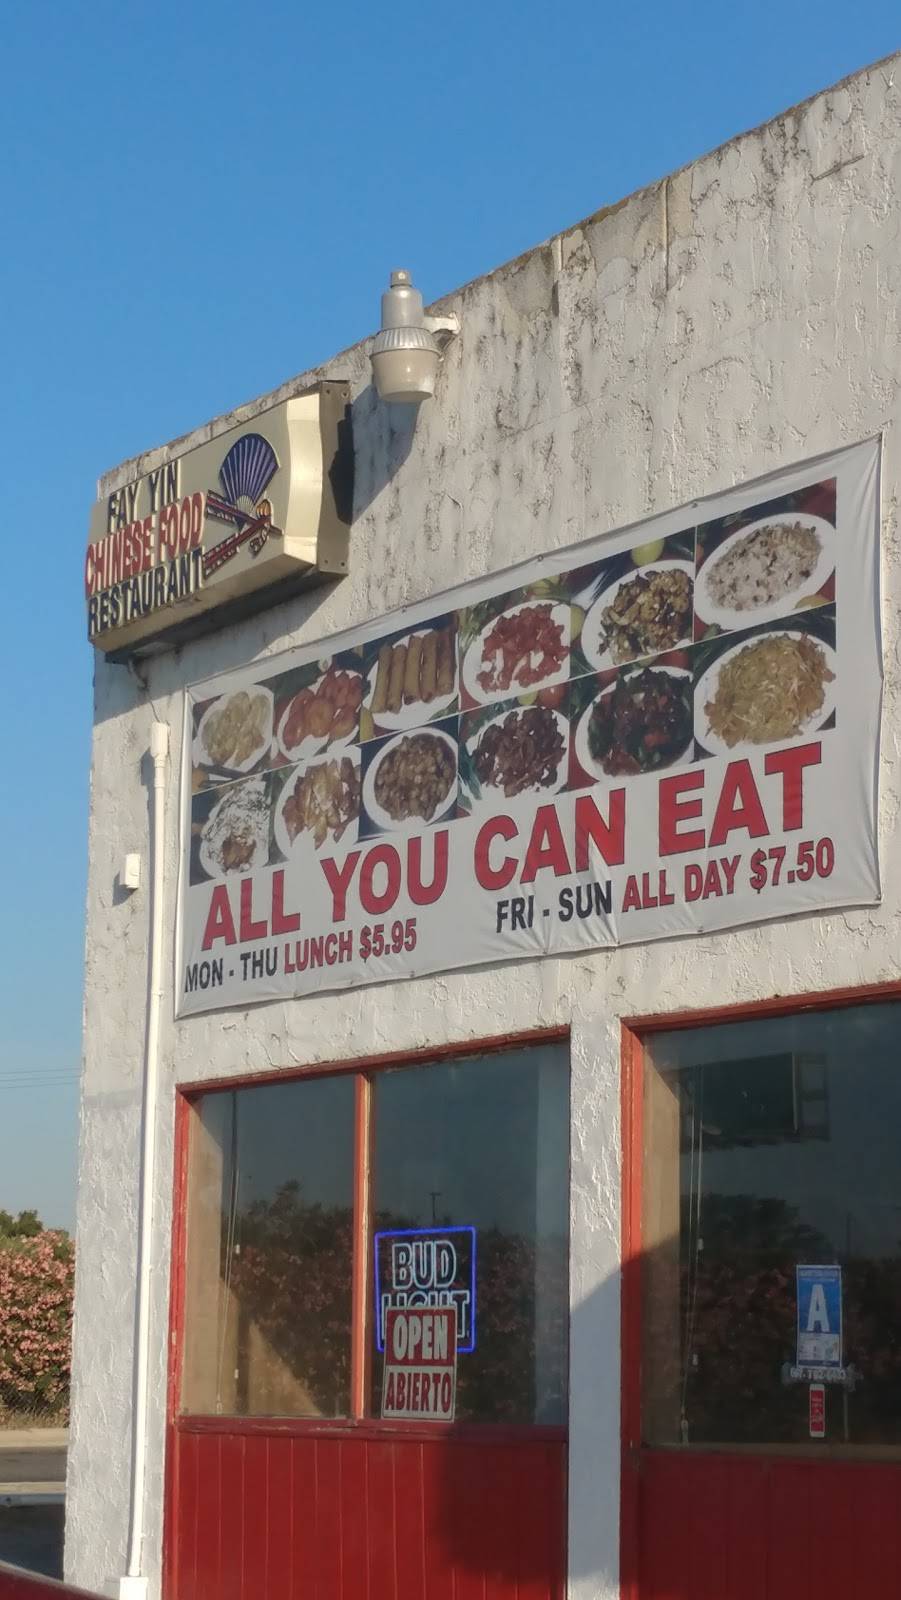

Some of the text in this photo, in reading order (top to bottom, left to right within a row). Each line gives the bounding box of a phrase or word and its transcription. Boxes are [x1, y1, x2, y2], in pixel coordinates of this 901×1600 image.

[107, 457, 181, 534] FAY YIN
[85, 491, 206, 597] CHINESE FOOD
[88, 546, 205, 637] RESTAURANT
[201, 741, 822, 952] ALL YOU CAN EAT
[495, 894, 535, 934] FRI
[558, 880, 612, 922] SUN
[621, 869, 675, 913] ALL
[684, 854, 742, 903] DAY
[749, 837, 835, 894] $7.50
[184, 957, 224, 993] MON
[240, 946, 278, 982] THU
[284, 929, 353, 974] LUNCH
[359, 917, 417, 963] $5.95
[392, 1239, 457, 1290] BUD
[392, 1314, 448, 1361] OPEN
[807, 1283, 830, 1332] A
[384, 1371, 452, 1414] ABIERTO
